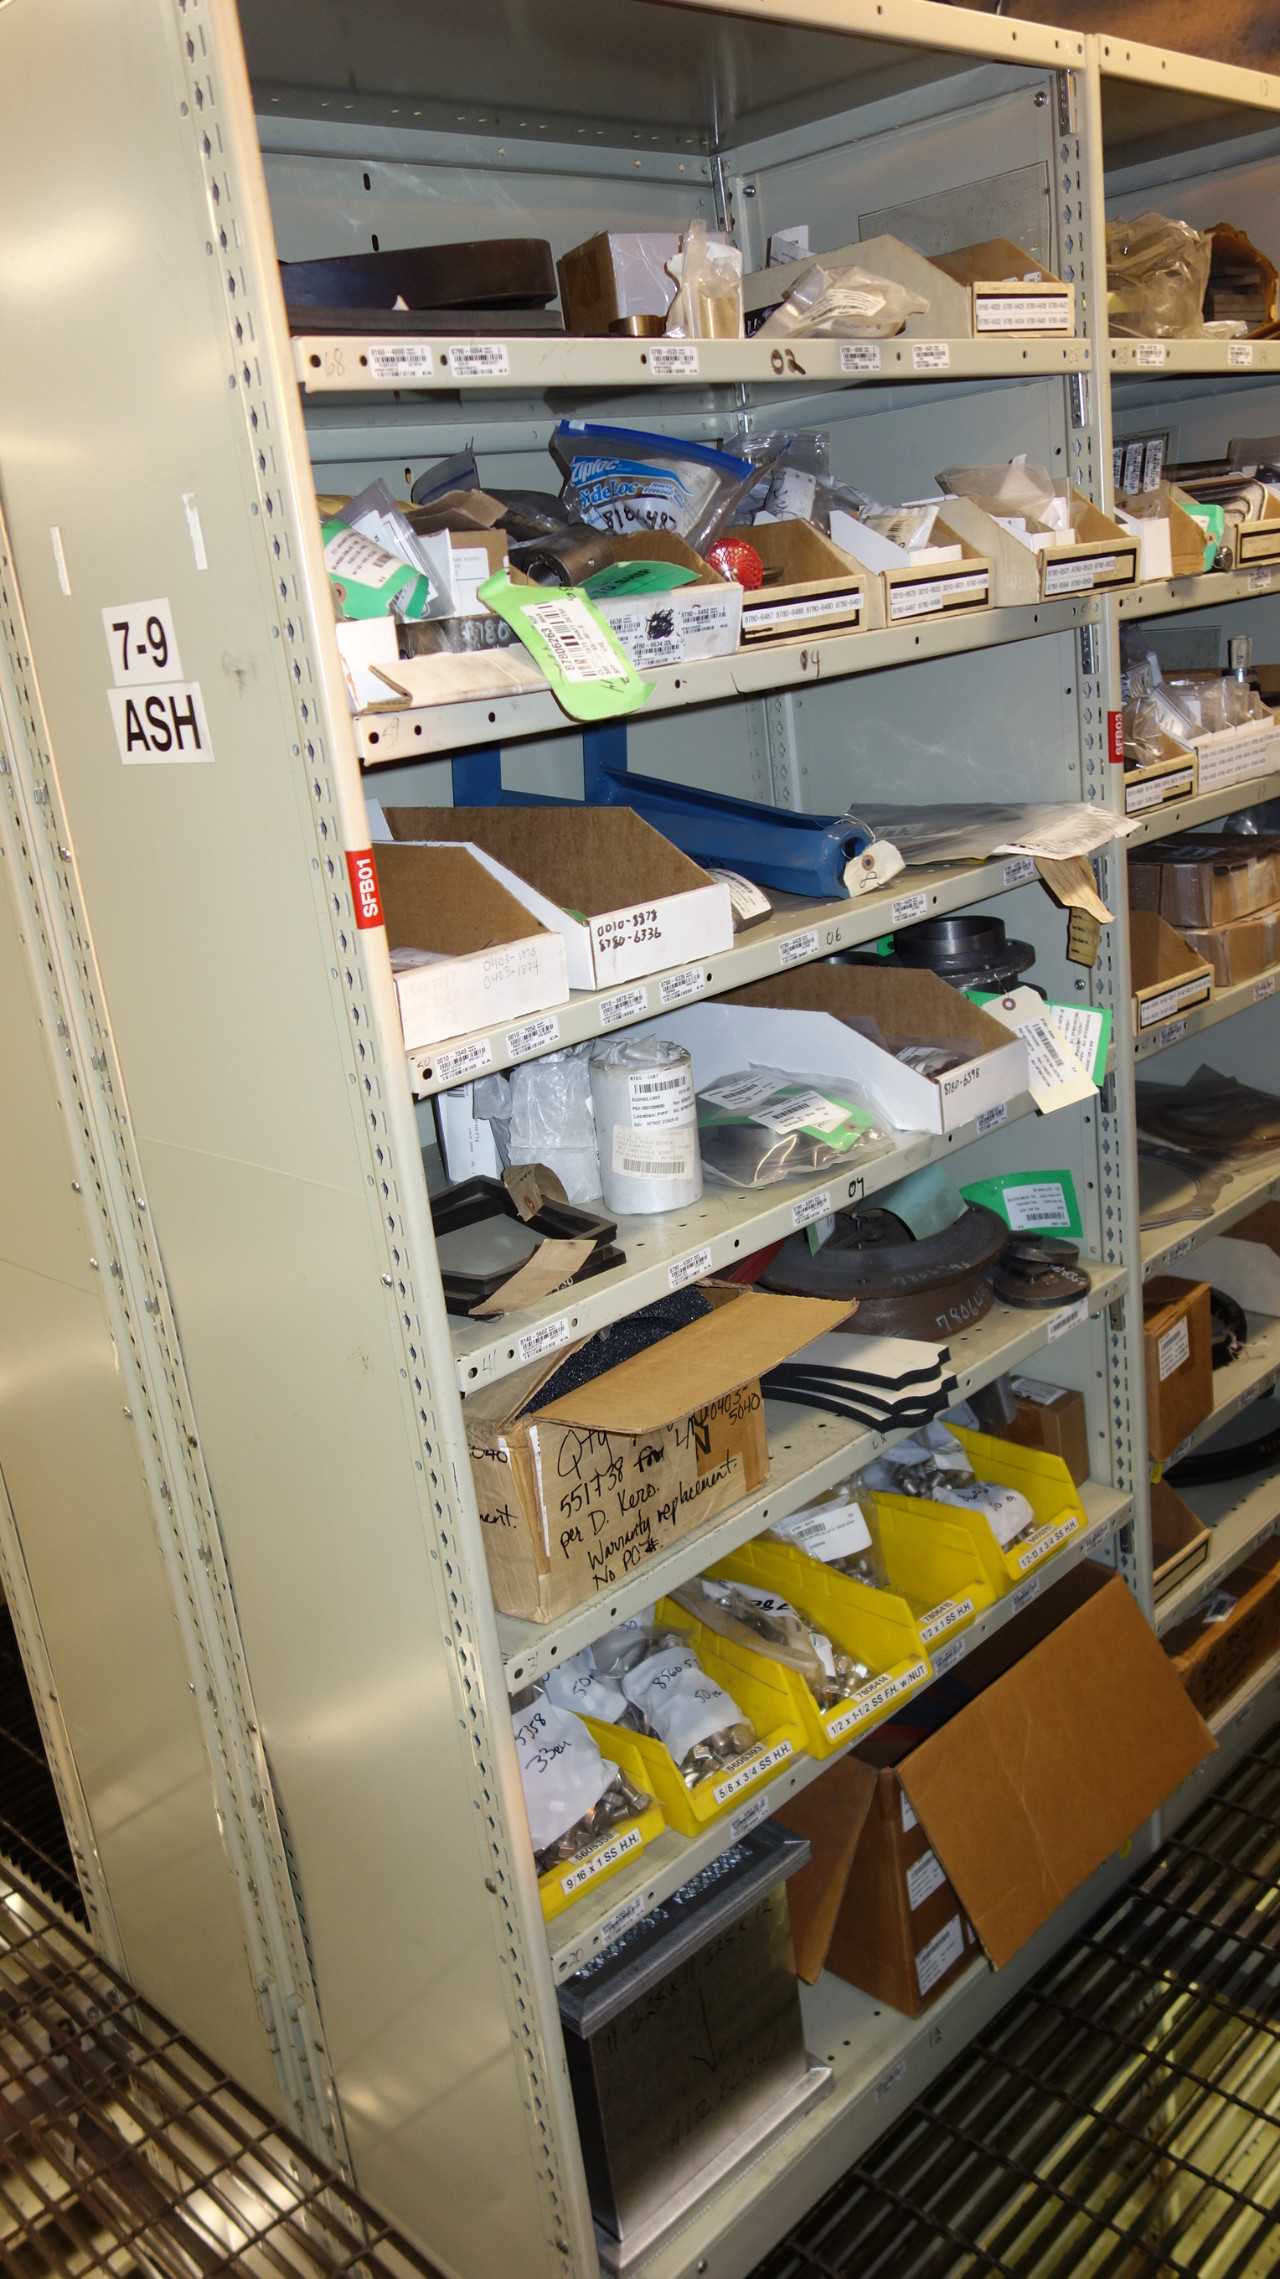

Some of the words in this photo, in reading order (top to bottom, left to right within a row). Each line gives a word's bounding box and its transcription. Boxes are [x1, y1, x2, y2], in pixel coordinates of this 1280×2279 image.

[112, 616, 168, 671] 7-9
[126, 694, 202, 752] ASH
[356, 858, 379, 918] SFB01
[560, 1526, 584, 1559] per
[588, 1509, 609, 1536] D.
[587, 1510, 651, 1570] Warranty
[592, 1565, 616, 1592] No
[945, 1612, 956, 1624] SS
[830, 1721, 844, 1735] 1/2
[871, 1694, 883, 1707] SS
[760, 1756, 772, 1770] SS
[566, 1869, 586, 1889] 9/16
[603, 1847, 618, 1862] SS
